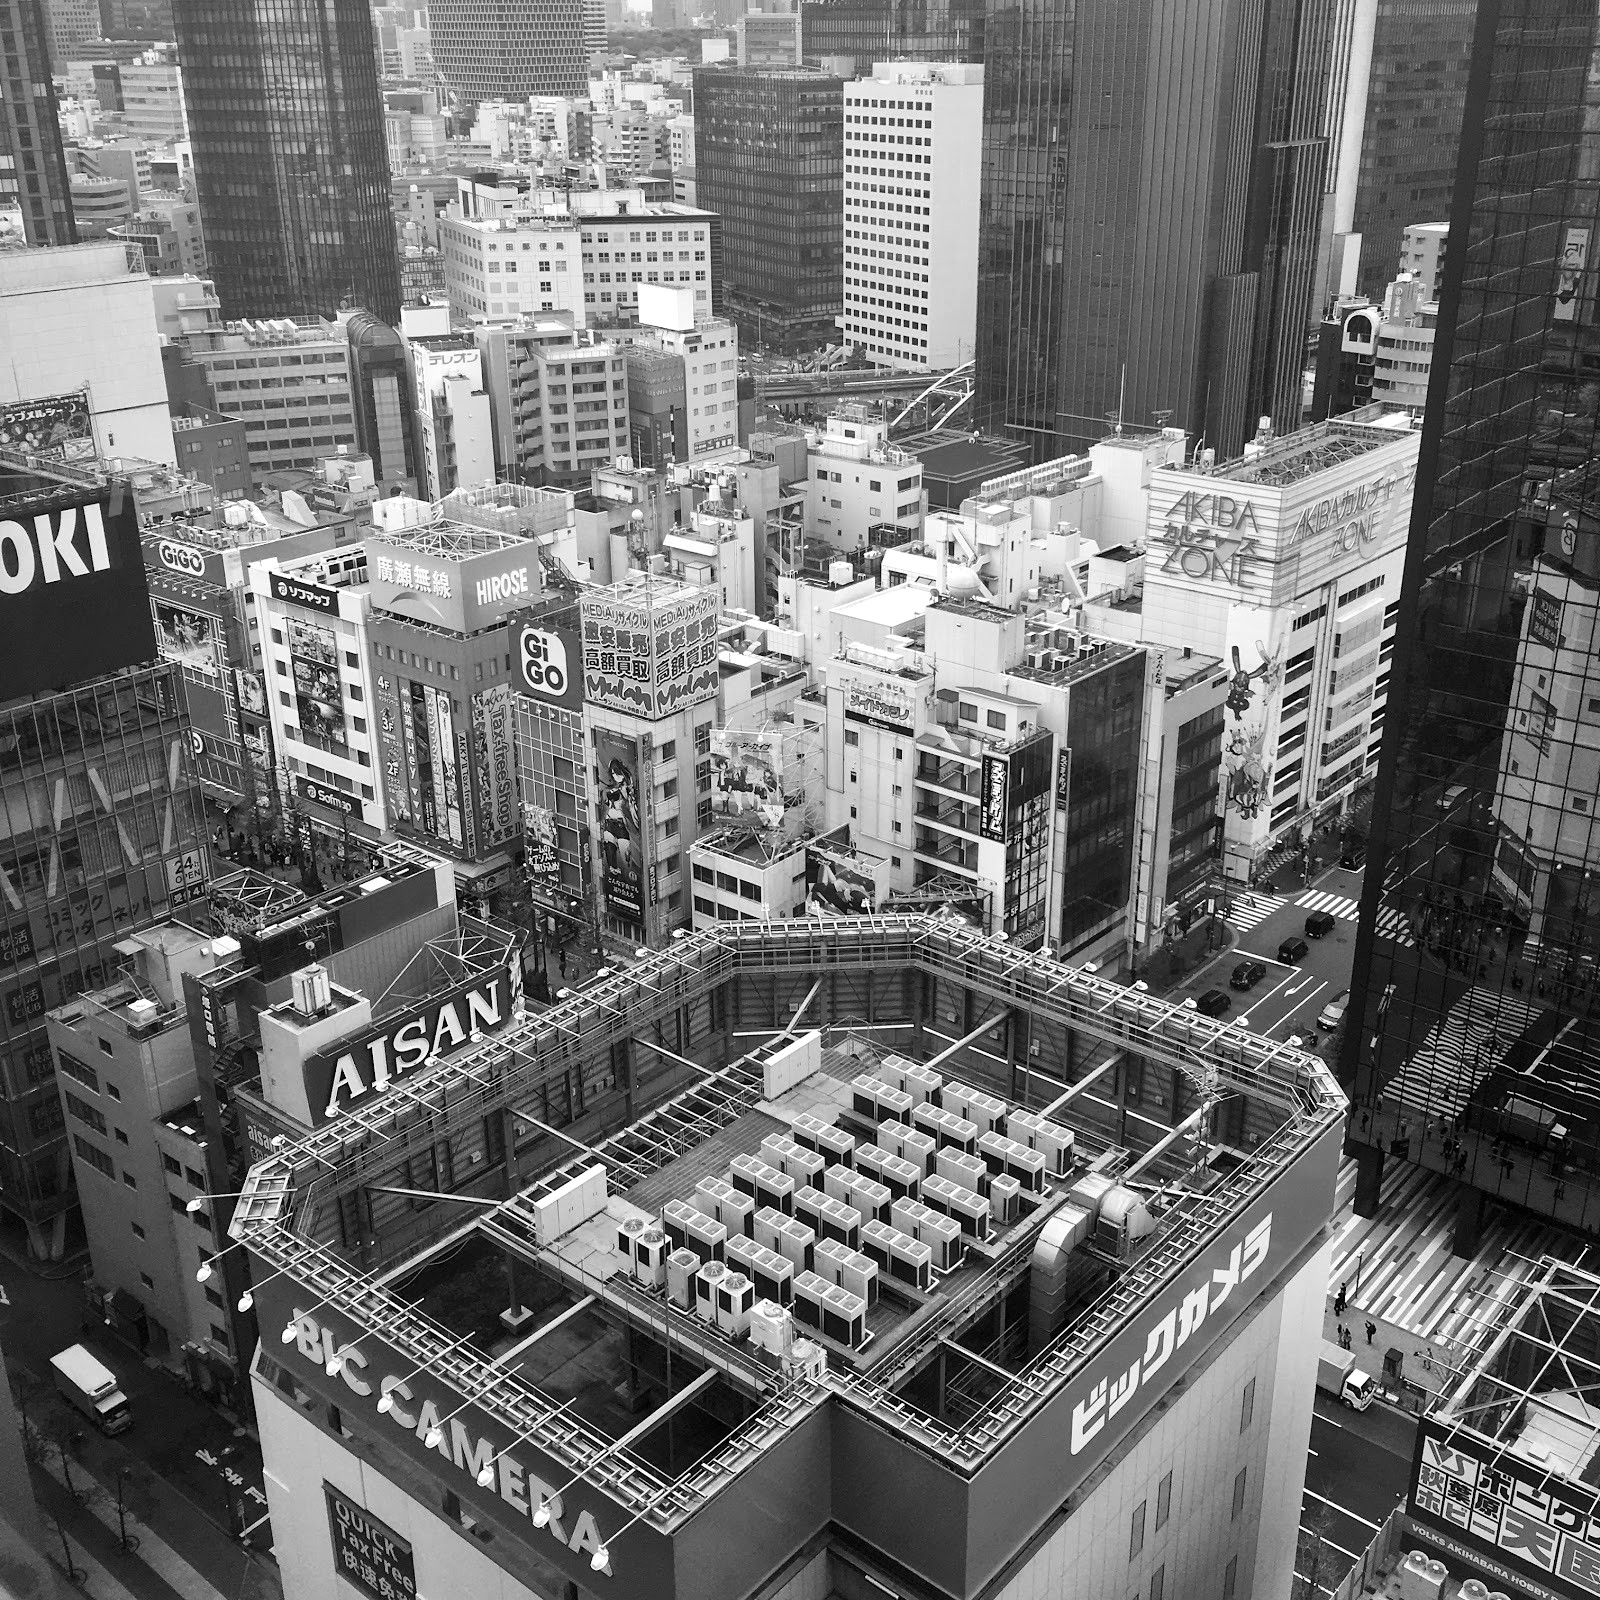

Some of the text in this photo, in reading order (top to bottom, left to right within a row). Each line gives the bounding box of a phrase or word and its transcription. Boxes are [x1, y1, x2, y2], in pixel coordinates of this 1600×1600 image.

[428, 353, 479, 366] テレオン
[5, 408, 63, 424] ラブメルシー
[1165, 490, 1259, 534] AKIBA
[0, 503, 111, 594] OKI
[1331, 511, 1381, 560] ZONE
[476, 568, 529, 606] HIROSE
[1160, 545, 1255, 589] ZONE
[289, 586, 331, 607] ソフマップ
[584, 620, 650, 656] 激安販売
[655, 614, 717, 658] 激安販売
[377, 675, 390, 690] 4F
[526, 659, 564, 691] GO
[585, 648, 650, 682] 高額買取
[655, 640, 717, 687] 高額買取
[586, 674, 653, 712] Mulan
[656, 670, 719, 715] Mulan
[381, 717, 394, 732] 3F
[490, 704, 510, 782] Tax-free
[725, 741, 772, 751] ブルーアーカイブ
[387, 761, 399, 776] 2F
[407, 741, 416, 780] Hey
[317, 790, 353, 813] Sofmap
[458, 734, 467, 764] AKKY
[466, 809, 475, 833] Shop
[496, 778, 513, 827] Shop
[44, 893, 104, 929] コミック
[55, 894, 157, 946] インターネット
[3, 943, 31, 962] CLUB
[14, 1002, 42, 1020] CLUB
[329, 979, 502, 1110] AISAN
[1070, 1211, 1273, 1456] ビックカメラ
[292, 1307, 613, 1578] BIC CAMERA
[1415, 1485, 1499, 1544] ホビー
[1418, 1463, 1503, 1523] 秋葉原
[335, 1500, 398, 1562] QUICK
[337, 1518, 414, 1594] Tax Free
[1411, 1523, 1550, 1599] VOLKS AKIHABARA HOBBY
